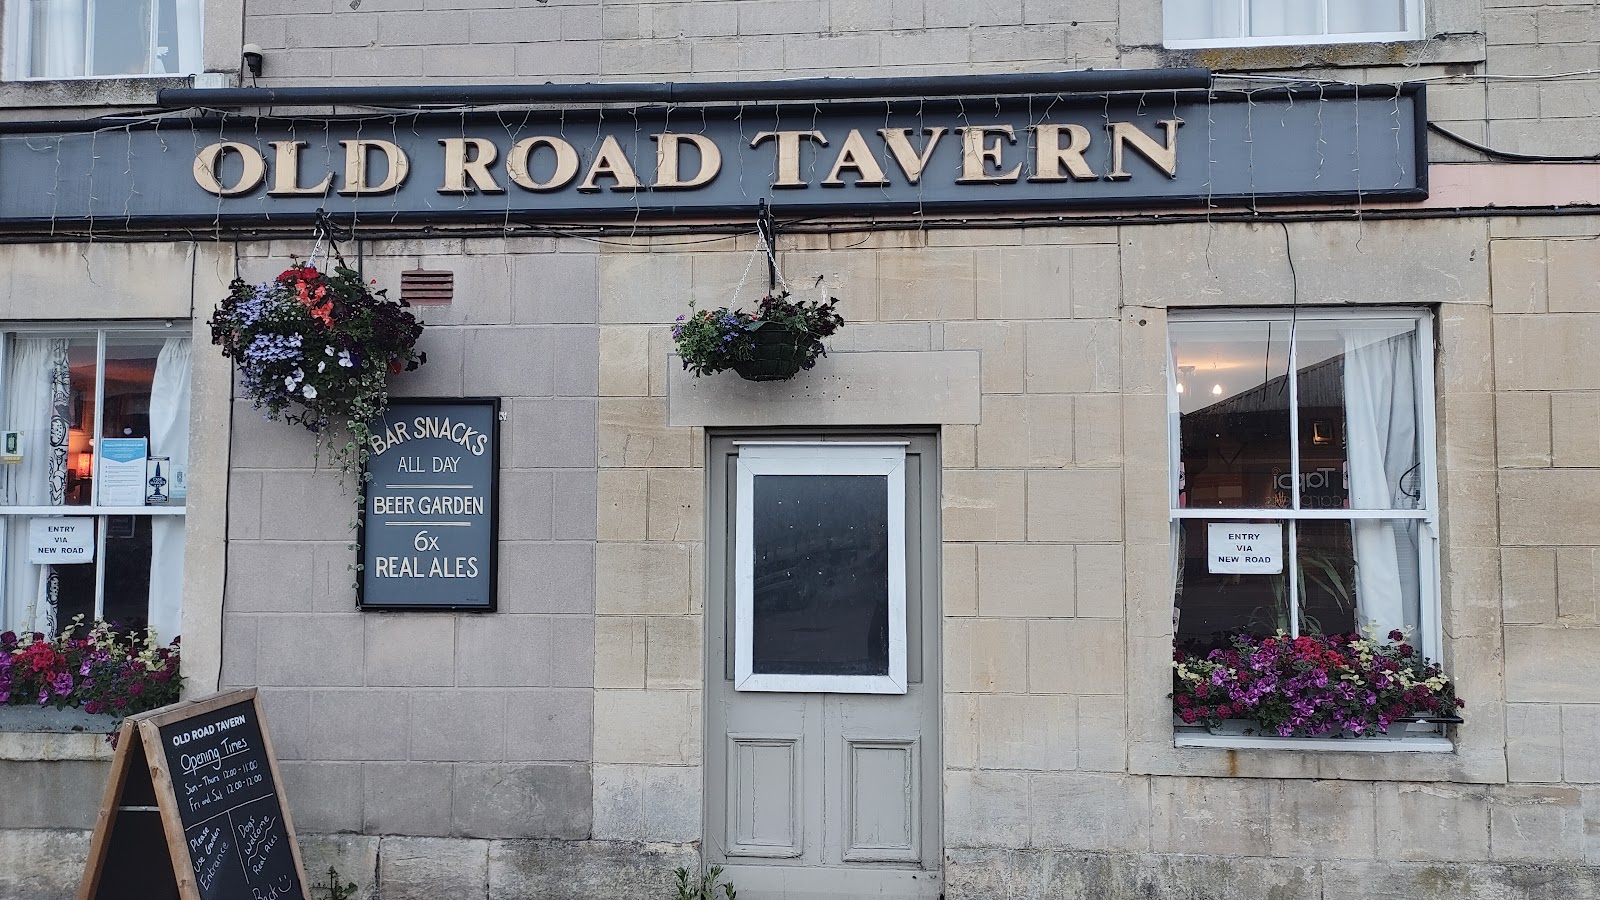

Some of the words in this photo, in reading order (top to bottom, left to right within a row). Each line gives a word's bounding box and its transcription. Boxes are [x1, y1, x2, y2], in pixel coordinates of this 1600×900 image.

[192, 138, 410, 197] OLD
[437, 133, 723, 195] ROAD
[749, 118, 1186, 189] TAVERN
[370, 421, 412, 456] BAR
[413, 416, 488, 456] SNACKS
[397, 456, 426, 473] ALL
[432, 456, 461, 473] DAY
[373, 496, 415, 515] BEER
[418, 496, 484, 515] GARDEN
[375, 556, 425, 578] REAL
[428, 556, 479, 578] ALES
[172, 732, 190, 746] OLD
[191, 724, 215, 740] ROAD
[215, 714, 246, 732] TAVERN
[181, 748, 221, 776] Opening
[220, 737, 248, 755] Times
[189, 797, 201, 812] Fri
[202, 793, 212, 805] and
[190, 826, 210, 853] Please
[238, 815, 256, 839] Dogs
[193, 856, 205, 873] Use
[200, 842, 229, 891] Entrance
[252, 854, 267, 876] Real
[264, 834, 278, 854] Ales
